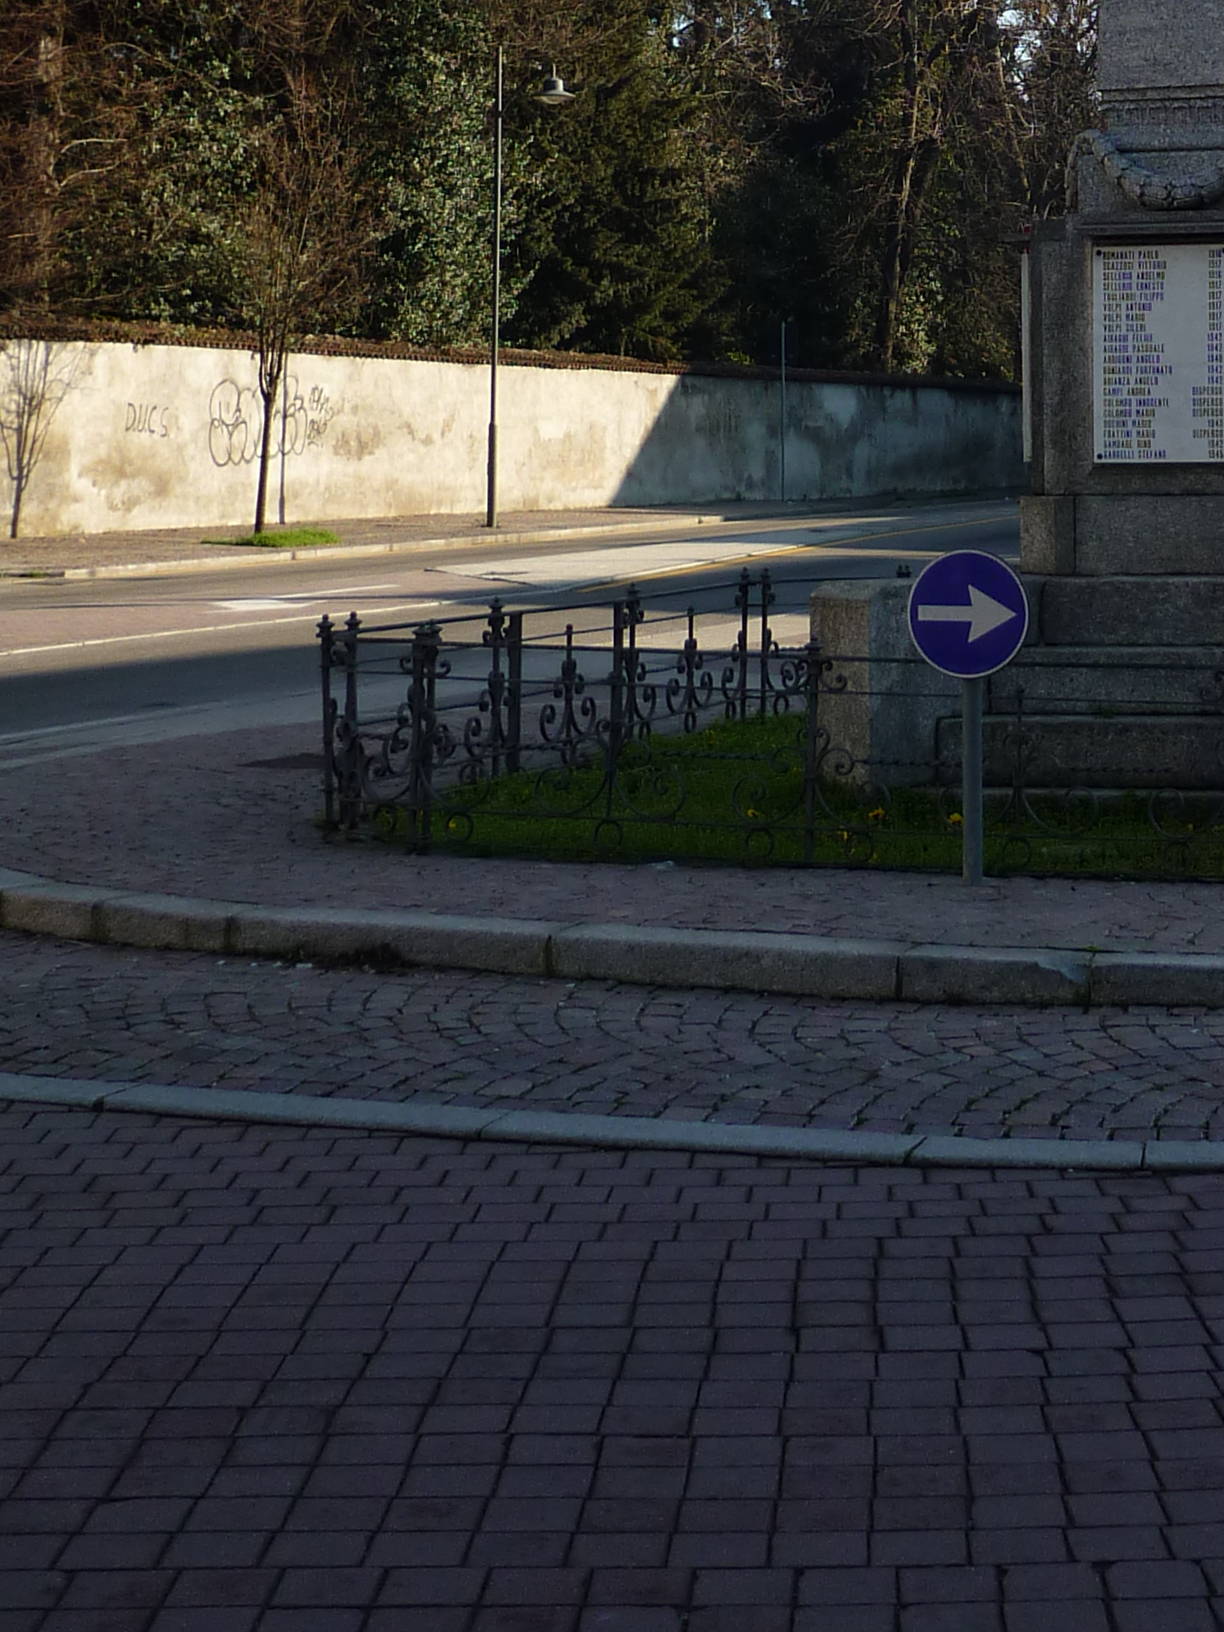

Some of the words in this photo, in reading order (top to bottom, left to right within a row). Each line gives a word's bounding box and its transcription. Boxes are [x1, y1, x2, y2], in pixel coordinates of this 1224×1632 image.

[1138, 250, 1159, 260] PAOLO
[1137, 260, 1167, 270] VITTORIO
[1136, 271, 1166, 280] ANSELMO
[1136, 281, 1164, 290] ERNESTO
[1139, 292, 1165, 301] FILIPPO
[1103, 303, 1122, 312] VOLPI
[1126, 302, 1152, 311] ANTONIO
[1103, 313, 1122, 322] VOLPI
[1125, 313, 1145, 322] MARIO
[1103, 323, 1122, 332] VOLPI
[1132, 343, 1165, 353] PASQUALE
[1136, 354, 1161, 363] ANGELO
[1135, 365, 1173, 375] FORTUNATO
[1103, 376, 1130, 386] BRIANZA
[1134, 376, 1159, 385] ANGELO
[1103, 387, 1123, 397] CAMPI
[1127, 386, 1151, 396] ANDREA
[1192, 386, 1223, 396] DISPERSO
[1103, 398, 1132, 407] COLOMBO
[1136, 397, 1170, 407] INNOCENTE
[1192, 397, 1223, 407] DISPERSO
[1103, 408, 1132, 418] COLOMBO
[1136, 408, 1156, 417] MARIO
[1192, 408, 1224, 417] DISPERSO
[1103, 429, 1132, 439] FRATTINI
[1136, 428, 1156, 438] MARIO
[1192, 429, 1224, 438] DISPERSO
[1138, 449, 1166, 459] STEFANO
